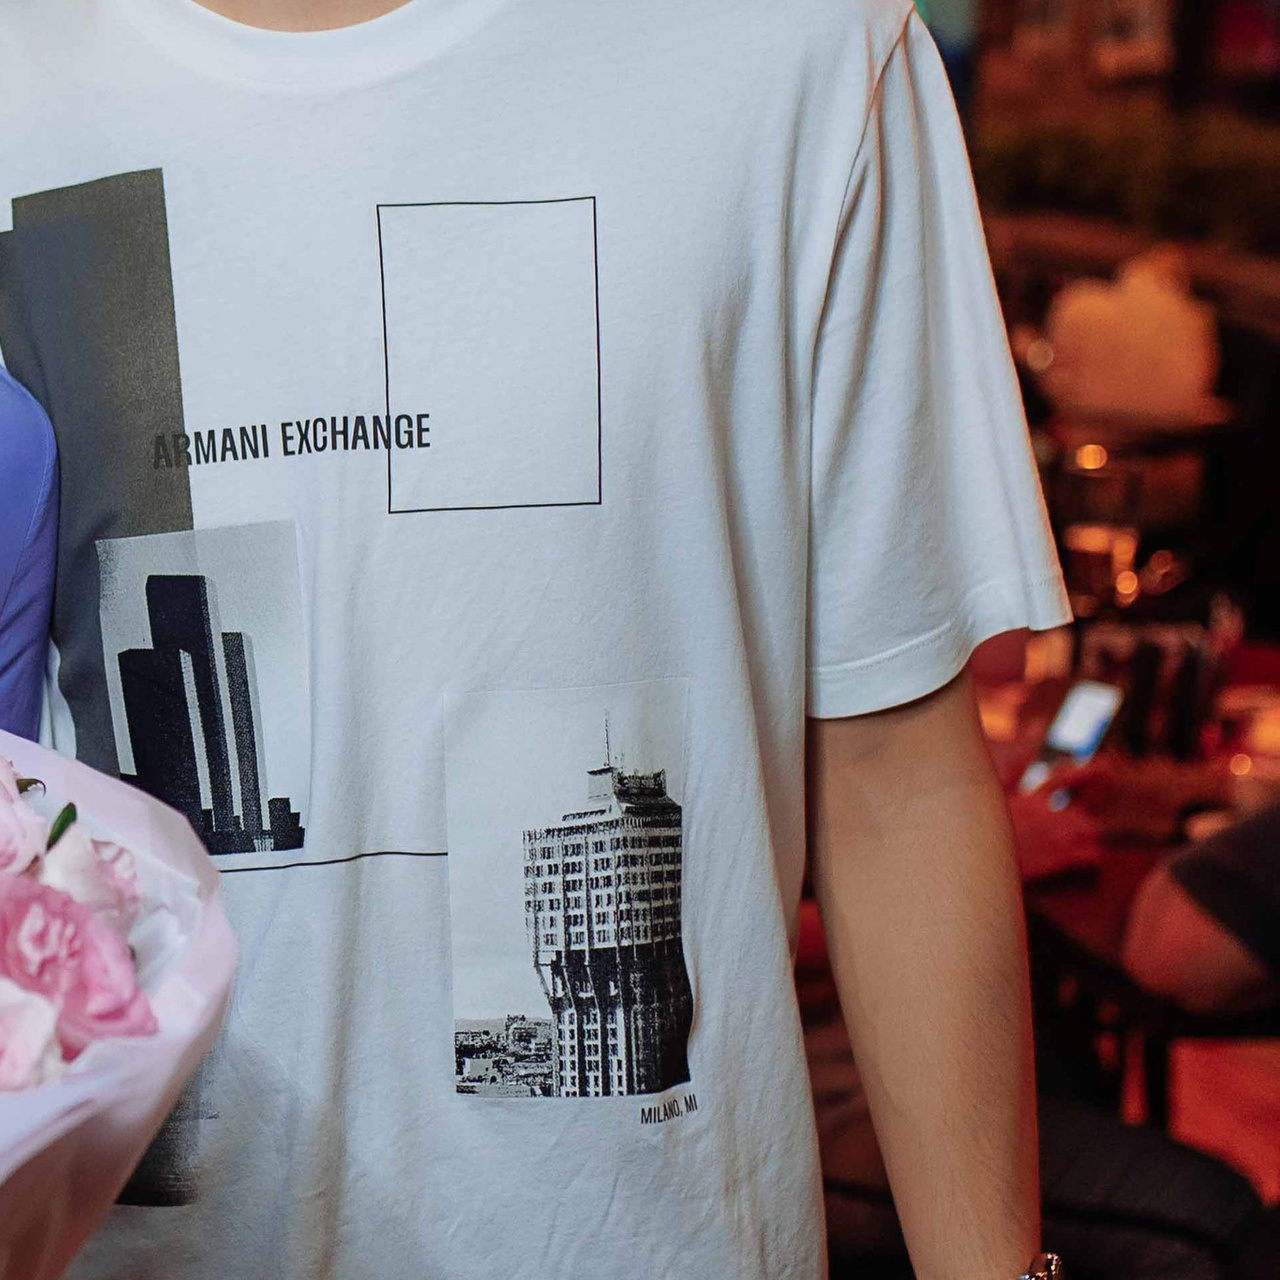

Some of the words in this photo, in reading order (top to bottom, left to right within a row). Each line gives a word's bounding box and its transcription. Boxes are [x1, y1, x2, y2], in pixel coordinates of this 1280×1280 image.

[153, 423, 270, 469] ARMANI
[281, 413, 431, 457] EXCHANGE
[640, 1099, 683, 1124] MILANO,
[684, 1093, 698, 1113] MI
